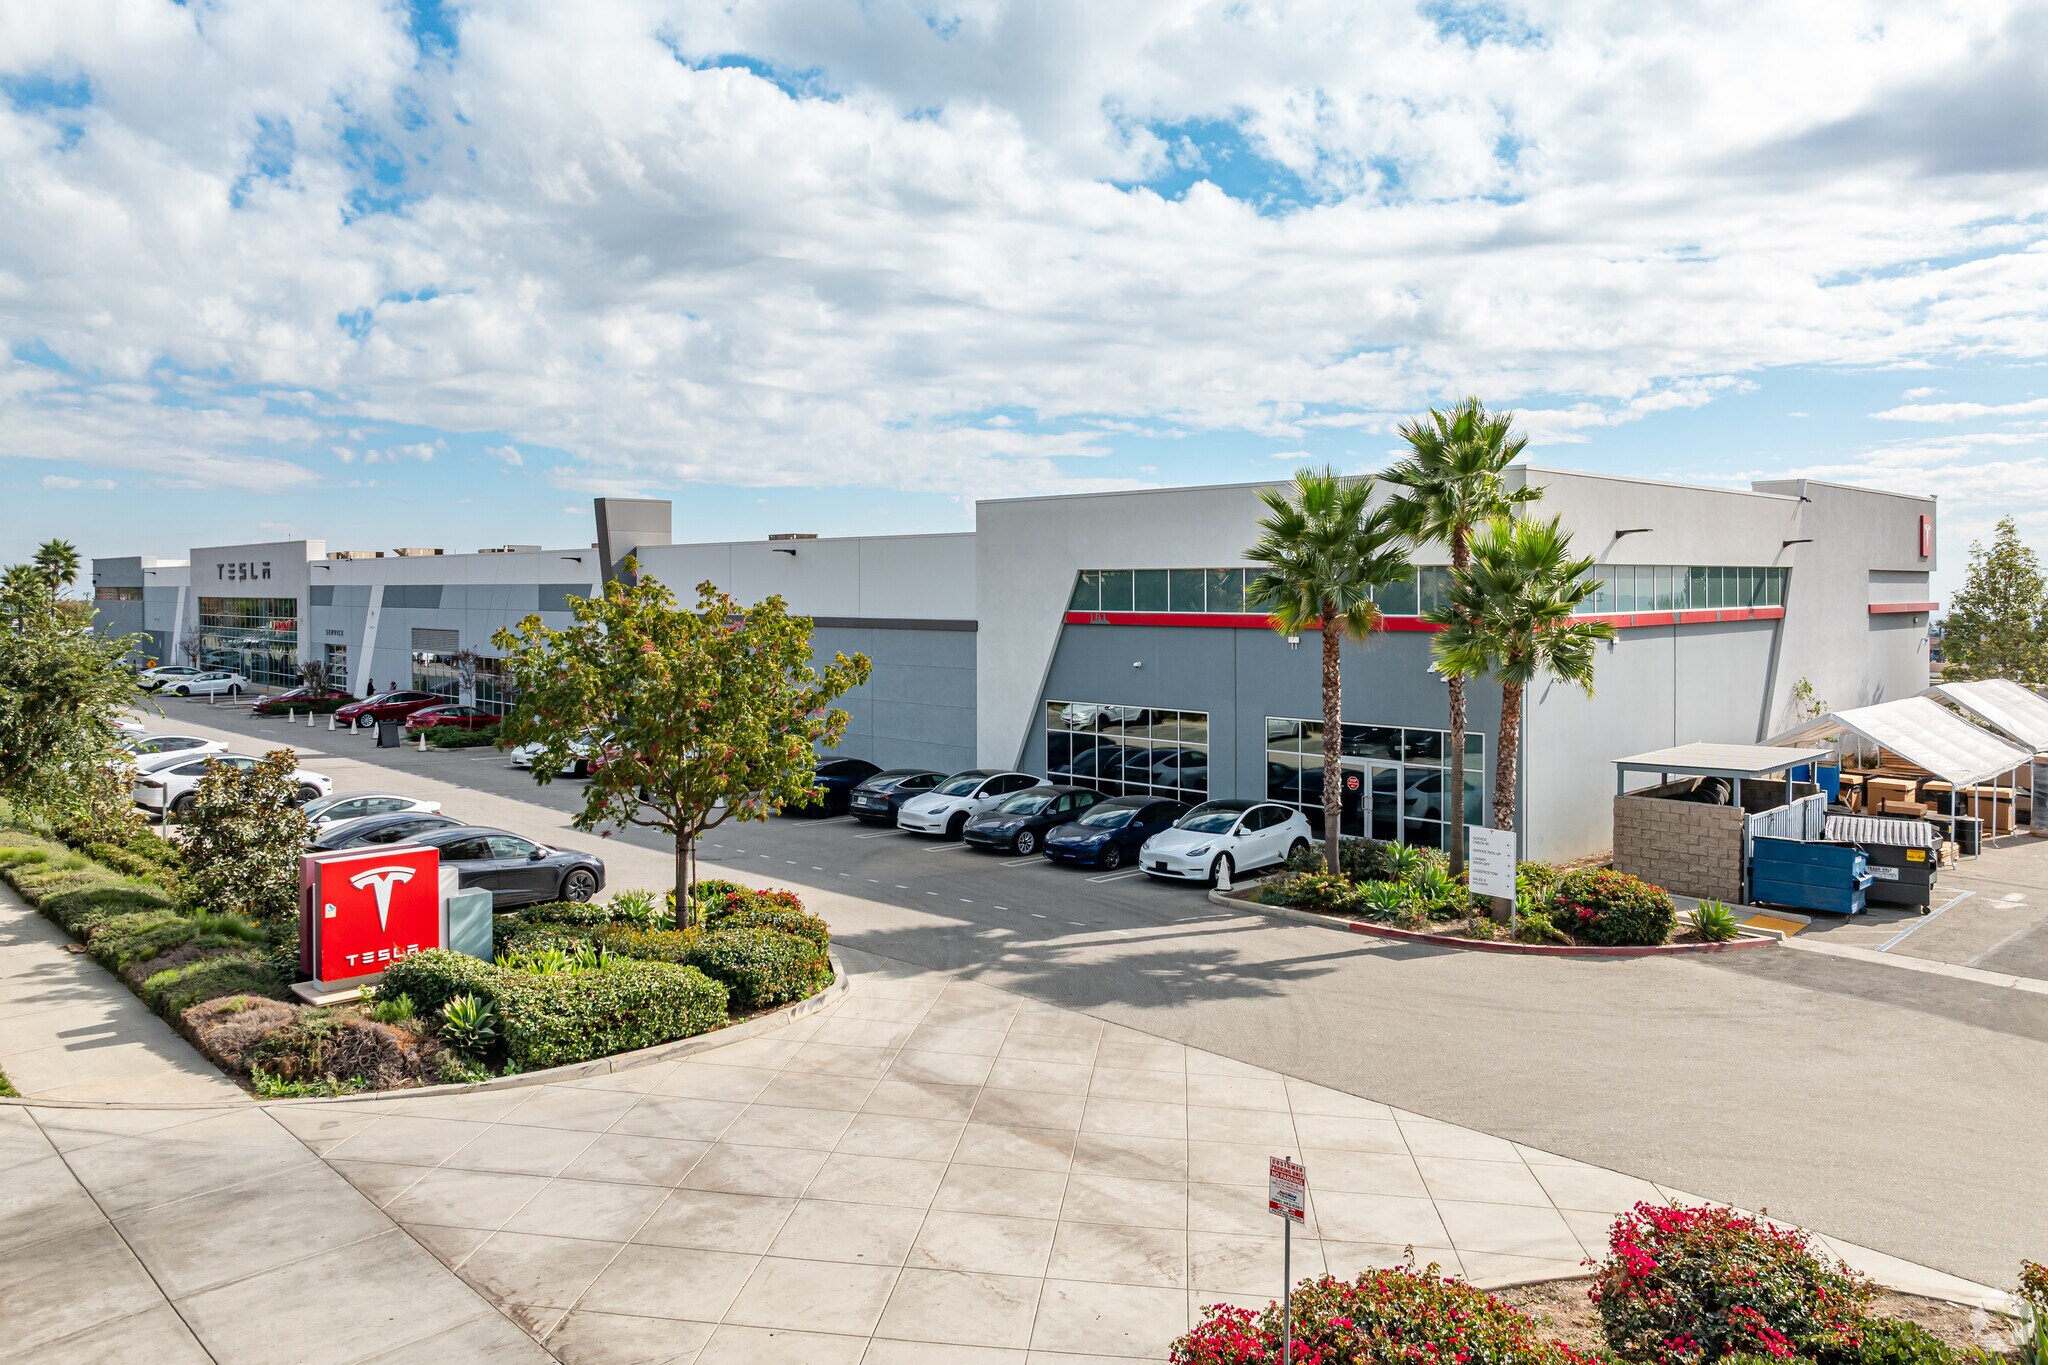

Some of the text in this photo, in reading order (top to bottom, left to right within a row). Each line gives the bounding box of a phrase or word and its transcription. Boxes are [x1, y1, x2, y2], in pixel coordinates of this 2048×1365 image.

[217, 562, 271, 581] TESLA
[325, 629, 344, 637] SERVICE
[345, 943, 419, 967] TESLA
[1271, 1158, 1303, 1173] CUSTOMER
[1271, 1164, 1304, 1179] PARKING ONLY
[1271, 1170, 1279, 1178] NO
[1280, 1173, 1303, 1185] PARKING
